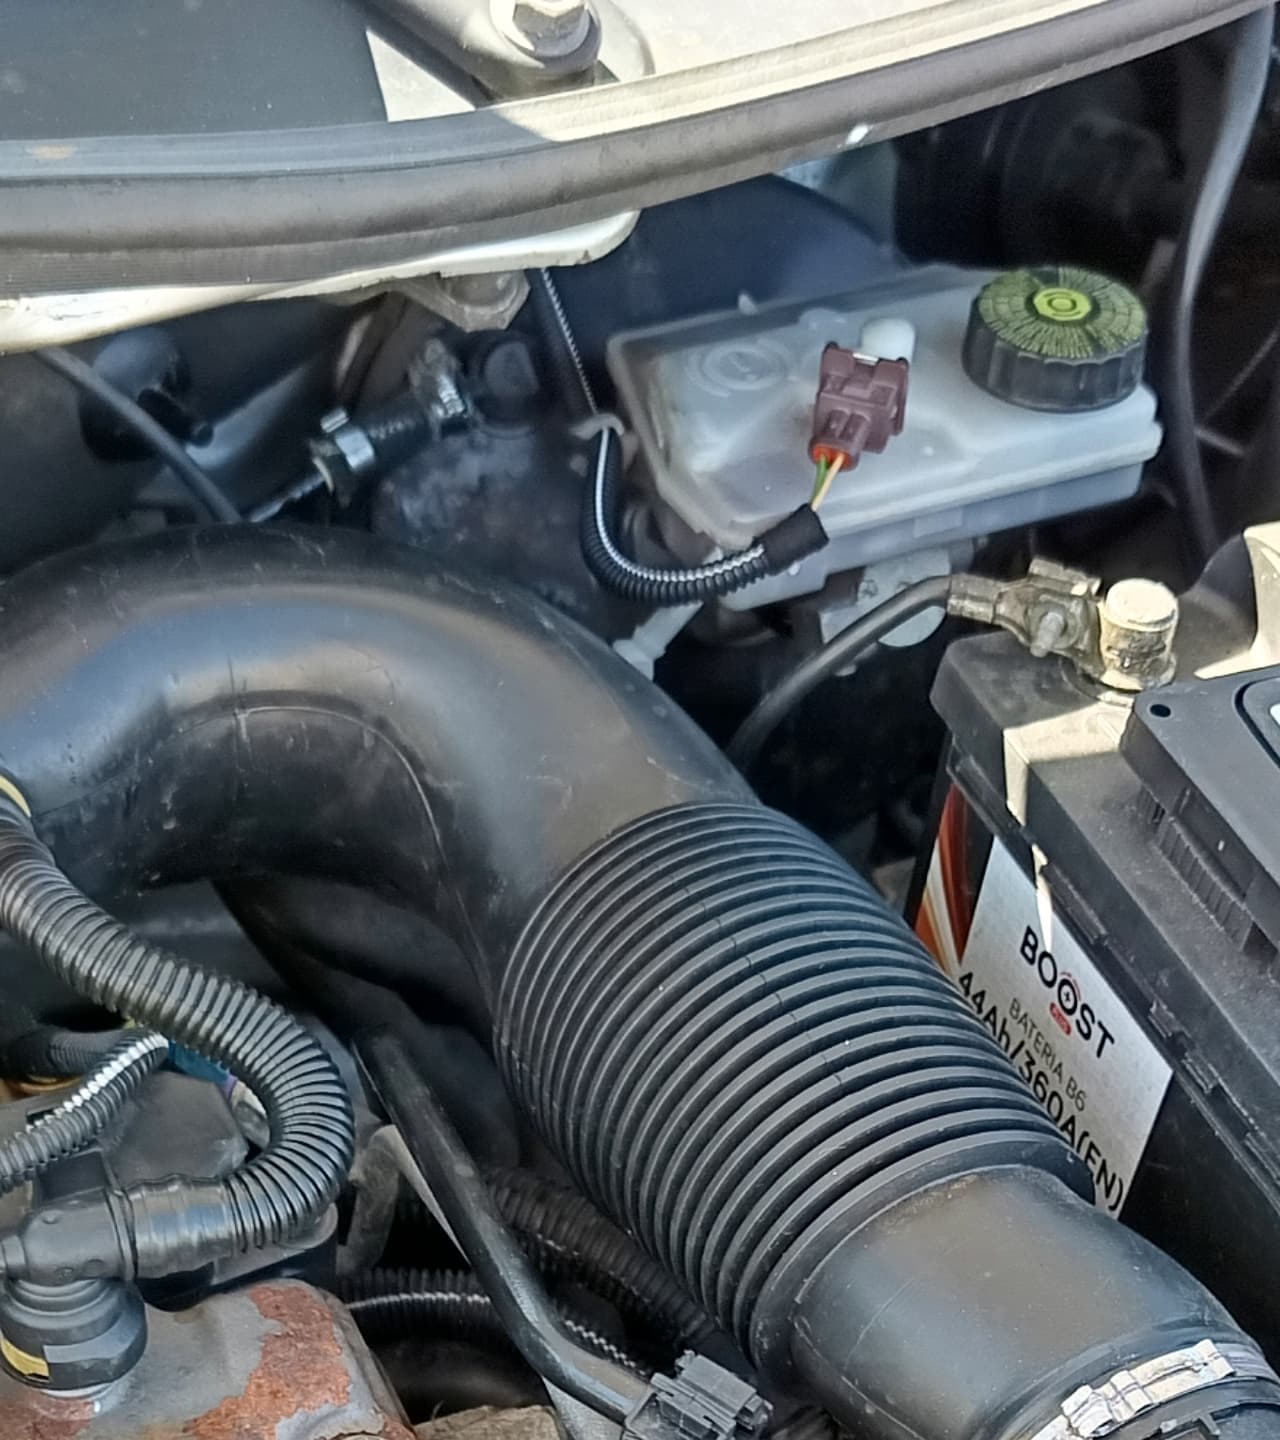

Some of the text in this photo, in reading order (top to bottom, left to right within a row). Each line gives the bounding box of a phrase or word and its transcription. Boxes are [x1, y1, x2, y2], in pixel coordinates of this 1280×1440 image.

[1021, 926, 1115, 1059] BOOST
[1009, 998, 1087, 1112] BATERIA B6
